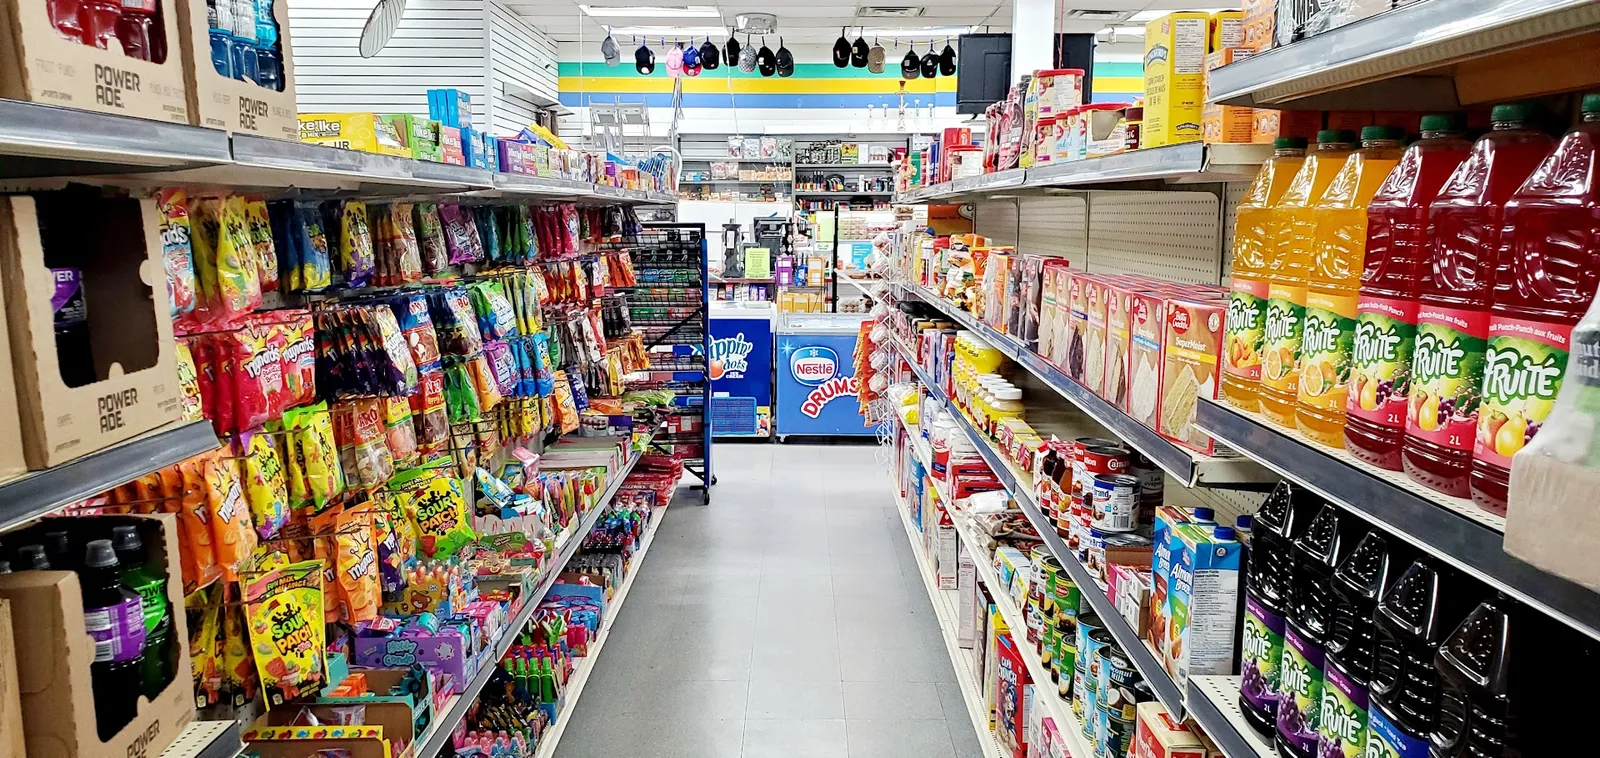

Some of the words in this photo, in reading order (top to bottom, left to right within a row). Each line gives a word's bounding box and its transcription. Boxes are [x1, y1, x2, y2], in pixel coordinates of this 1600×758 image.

[94, 63, 140, 92] POWER
[239, 96, 268, 118] POWER
[298, 120, 314, 132] ke
[319, 120, 341, 132] Ike
[1454, 316, 1468, 328] fruits
[1498, 324, 1533, 334] Punch-Punch
[1534, 328, 1546, 337] aux
[1547, 330, 1566, 344] fruits
[709, 333, 752, 360] ippin'
[1175, 337, 1206, 351] SuperMoist
[1354, 322, 1400, 366] FRUITÉ
[724, 359, 746, 370] dots
[1412, 334, 1464, 381] FRUITÉ
[1483, 348, 1560, 401] FRUITÉ
[98, 387, 138, 415] POWER
[802, 378, 860, 416] DRUMS
[1329, 400, 1338, 408] 2L
[416, 495, 453, 520] SOUR
[419, 505, 458, 533] PATCH
[272, 613, 306, 639] SOUR
[276, 626, 312, 653] PATCH
[1264, 704, 1271, 712] 2L
[1321, 687, 1361, 743] FRUITÉ
[126, 719, 160, 758] POWER
[1302, 743, 1310, 752] 2L
